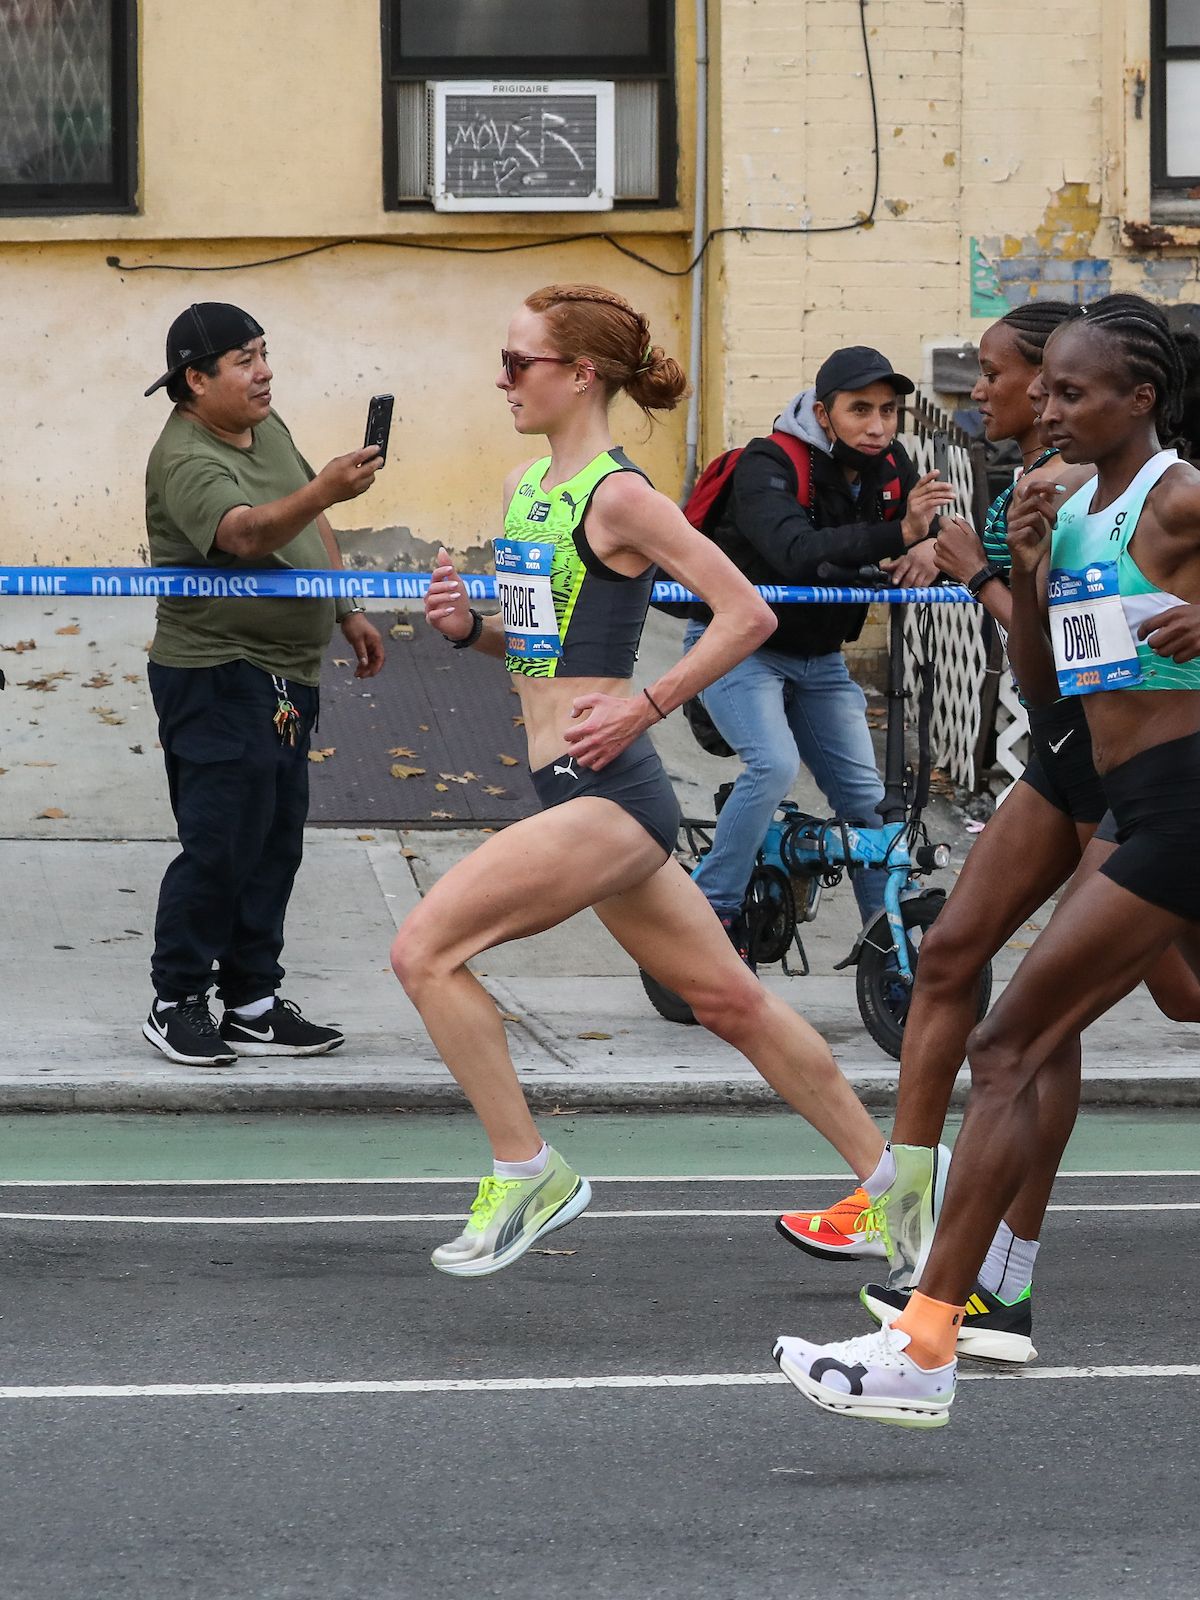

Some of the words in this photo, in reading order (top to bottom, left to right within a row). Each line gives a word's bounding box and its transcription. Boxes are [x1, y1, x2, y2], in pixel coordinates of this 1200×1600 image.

[492, 85, 549, 93] FRIGIDAIRE
[18, 576, 67, 595] LINE
[92, 576, 122, 596] DO
[130, 576, 174, 596] NOT
[183, 576, 258, 597] CROSS
[295, 577, 375, 598] POLICE
[1086, 583, 1104, 592] TATA
[499, 584, 539, 627] FRISBIE
[1063, 613, 1101, 662] OBIRI
[1076, 671, 1101, 687] 2022
